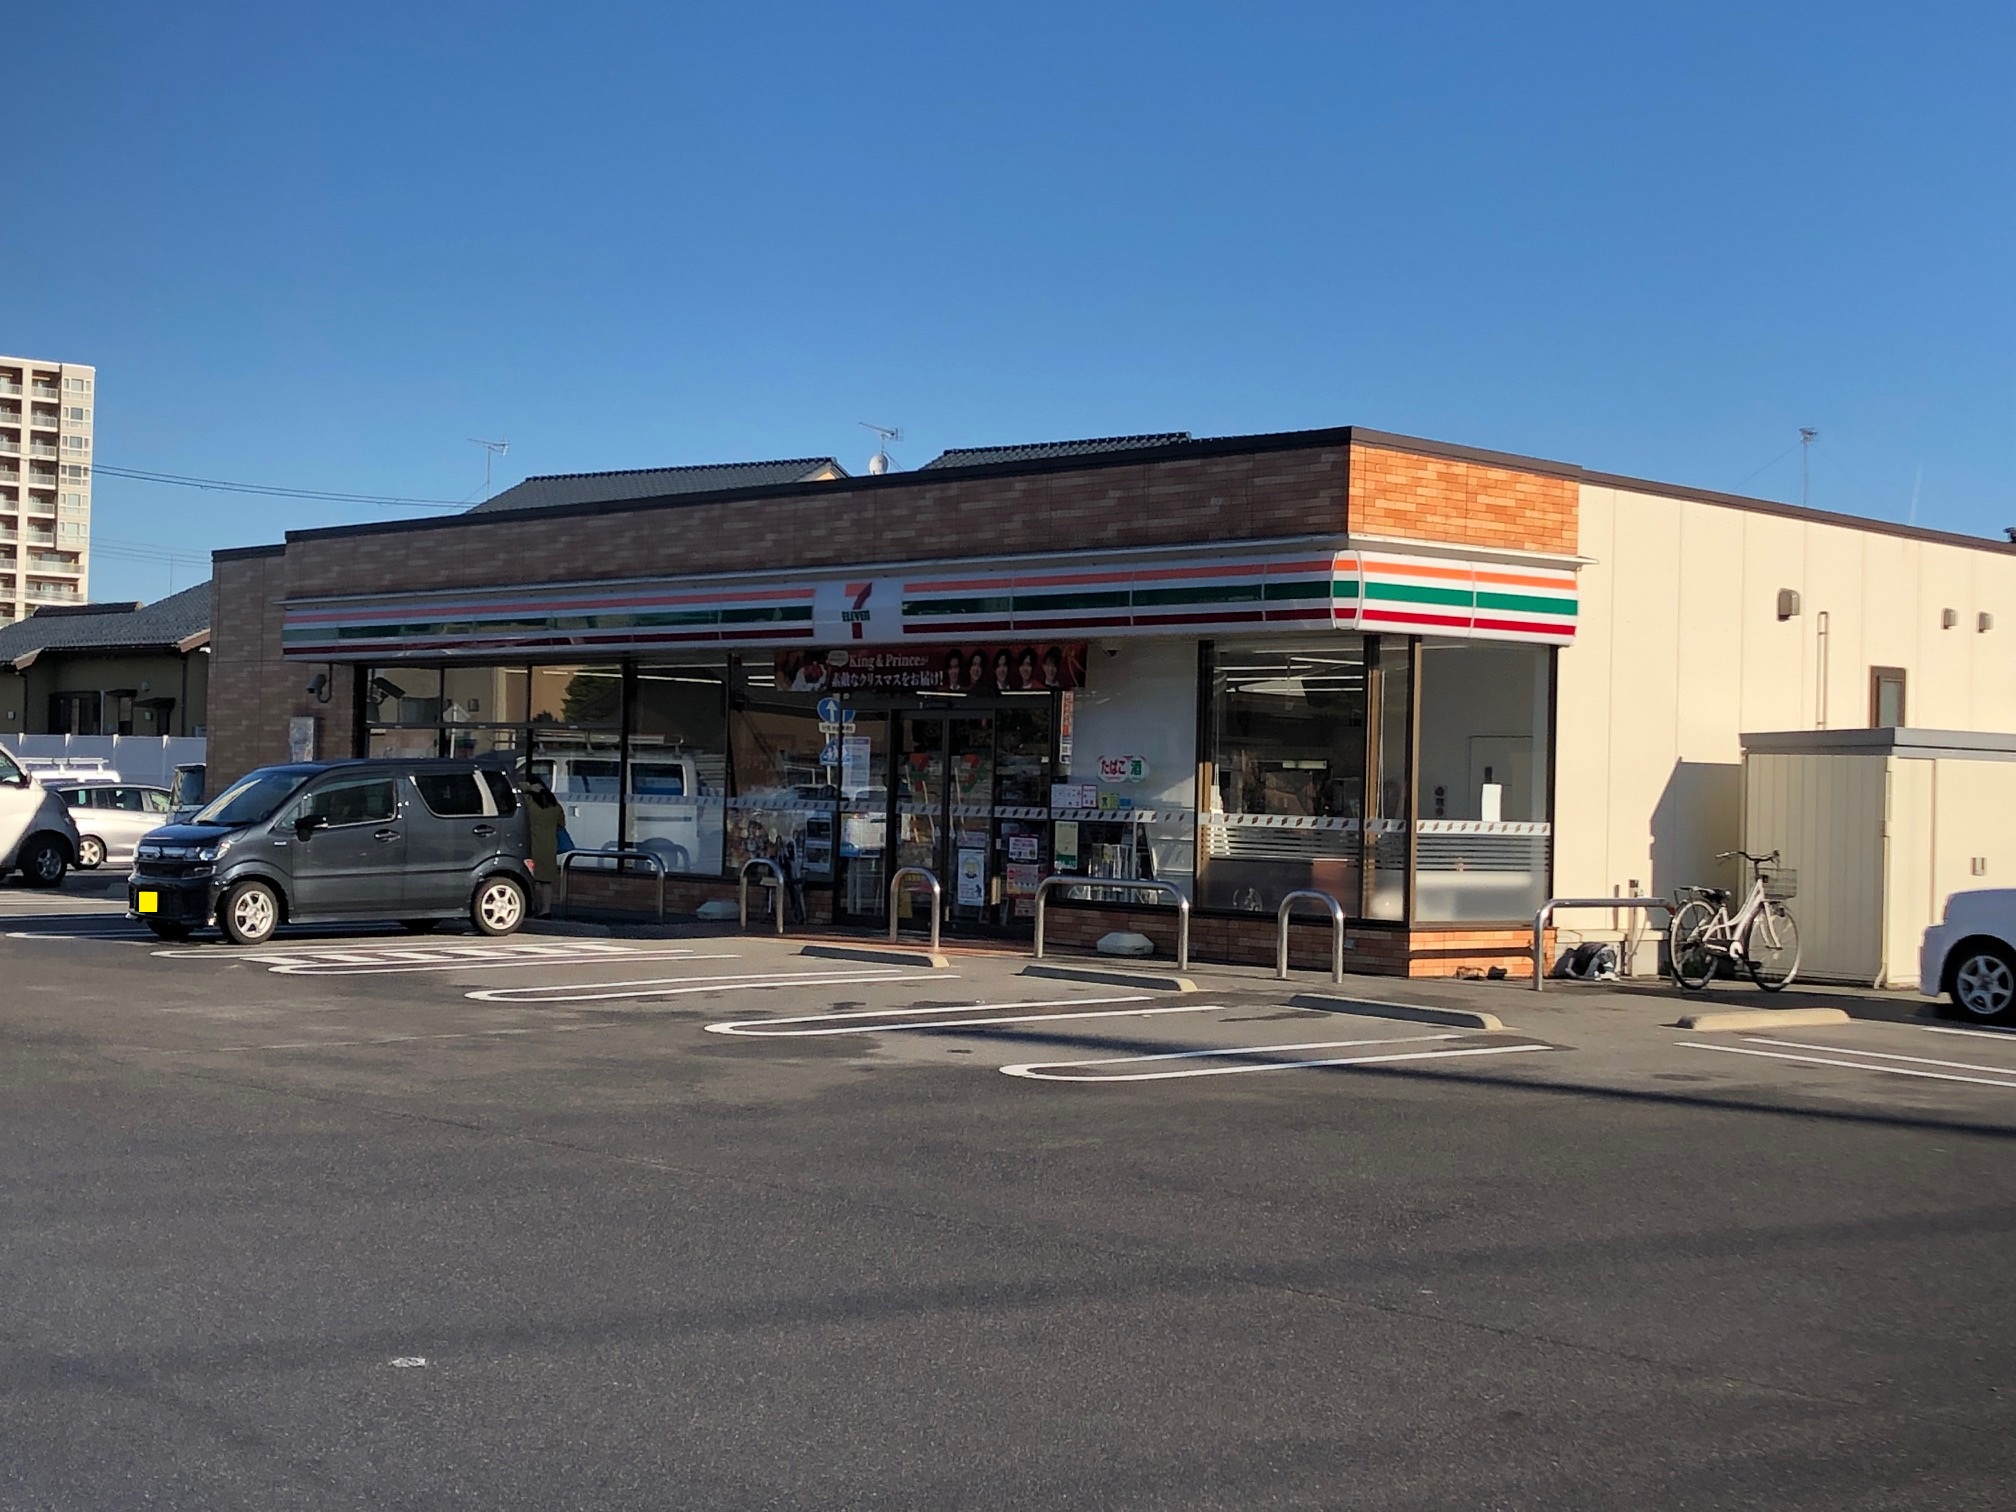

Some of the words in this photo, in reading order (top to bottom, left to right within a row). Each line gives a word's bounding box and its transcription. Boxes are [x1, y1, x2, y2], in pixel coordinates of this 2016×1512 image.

[849, 654, 875, 671] King
[875, 653, 884, 667] &
[1101, 759, 1126, 775] たばこ
[1130, 759, 1142, 775] 酒
